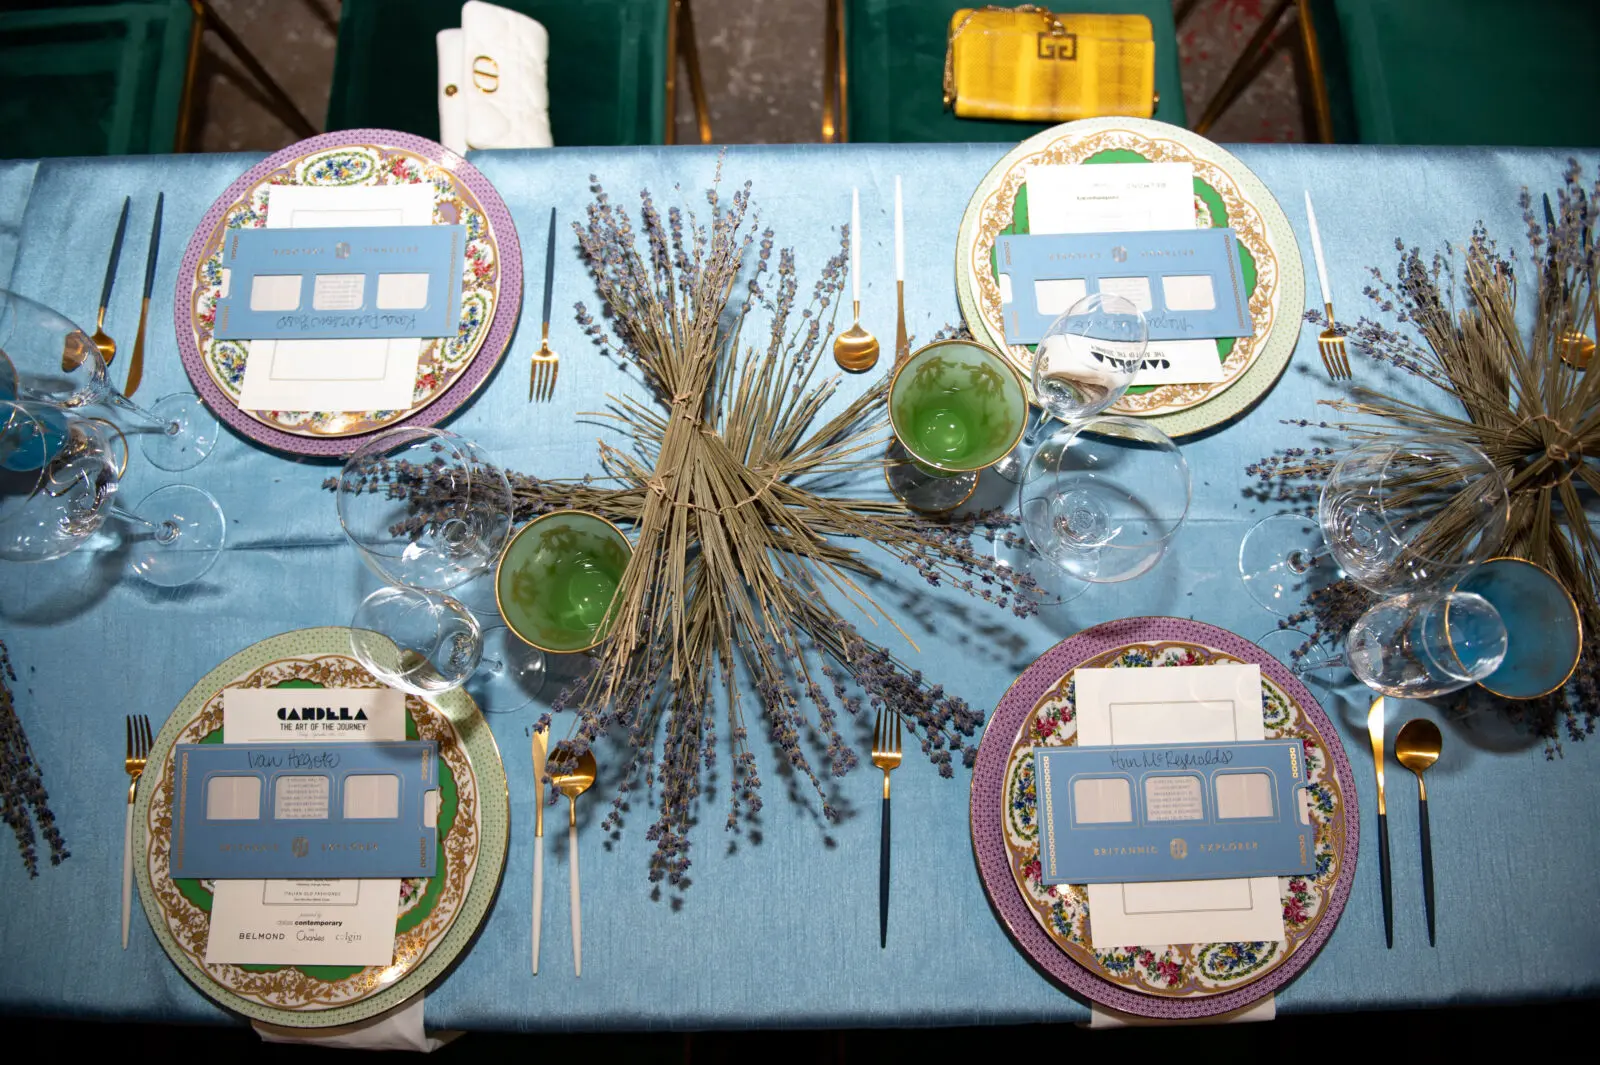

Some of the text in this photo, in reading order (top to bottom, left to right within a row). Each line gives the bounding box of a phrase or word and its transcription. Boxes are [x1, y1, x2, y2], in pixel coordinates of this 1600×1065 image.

[277, 708, 369, 720] CANDELA
[280, 723, 366, 731] THE ART OF THE JOURNEY
[1093, 842, 1259, 856] BRITANNIC EXPLORER
[238, 932, 286, 940] BELMOND
